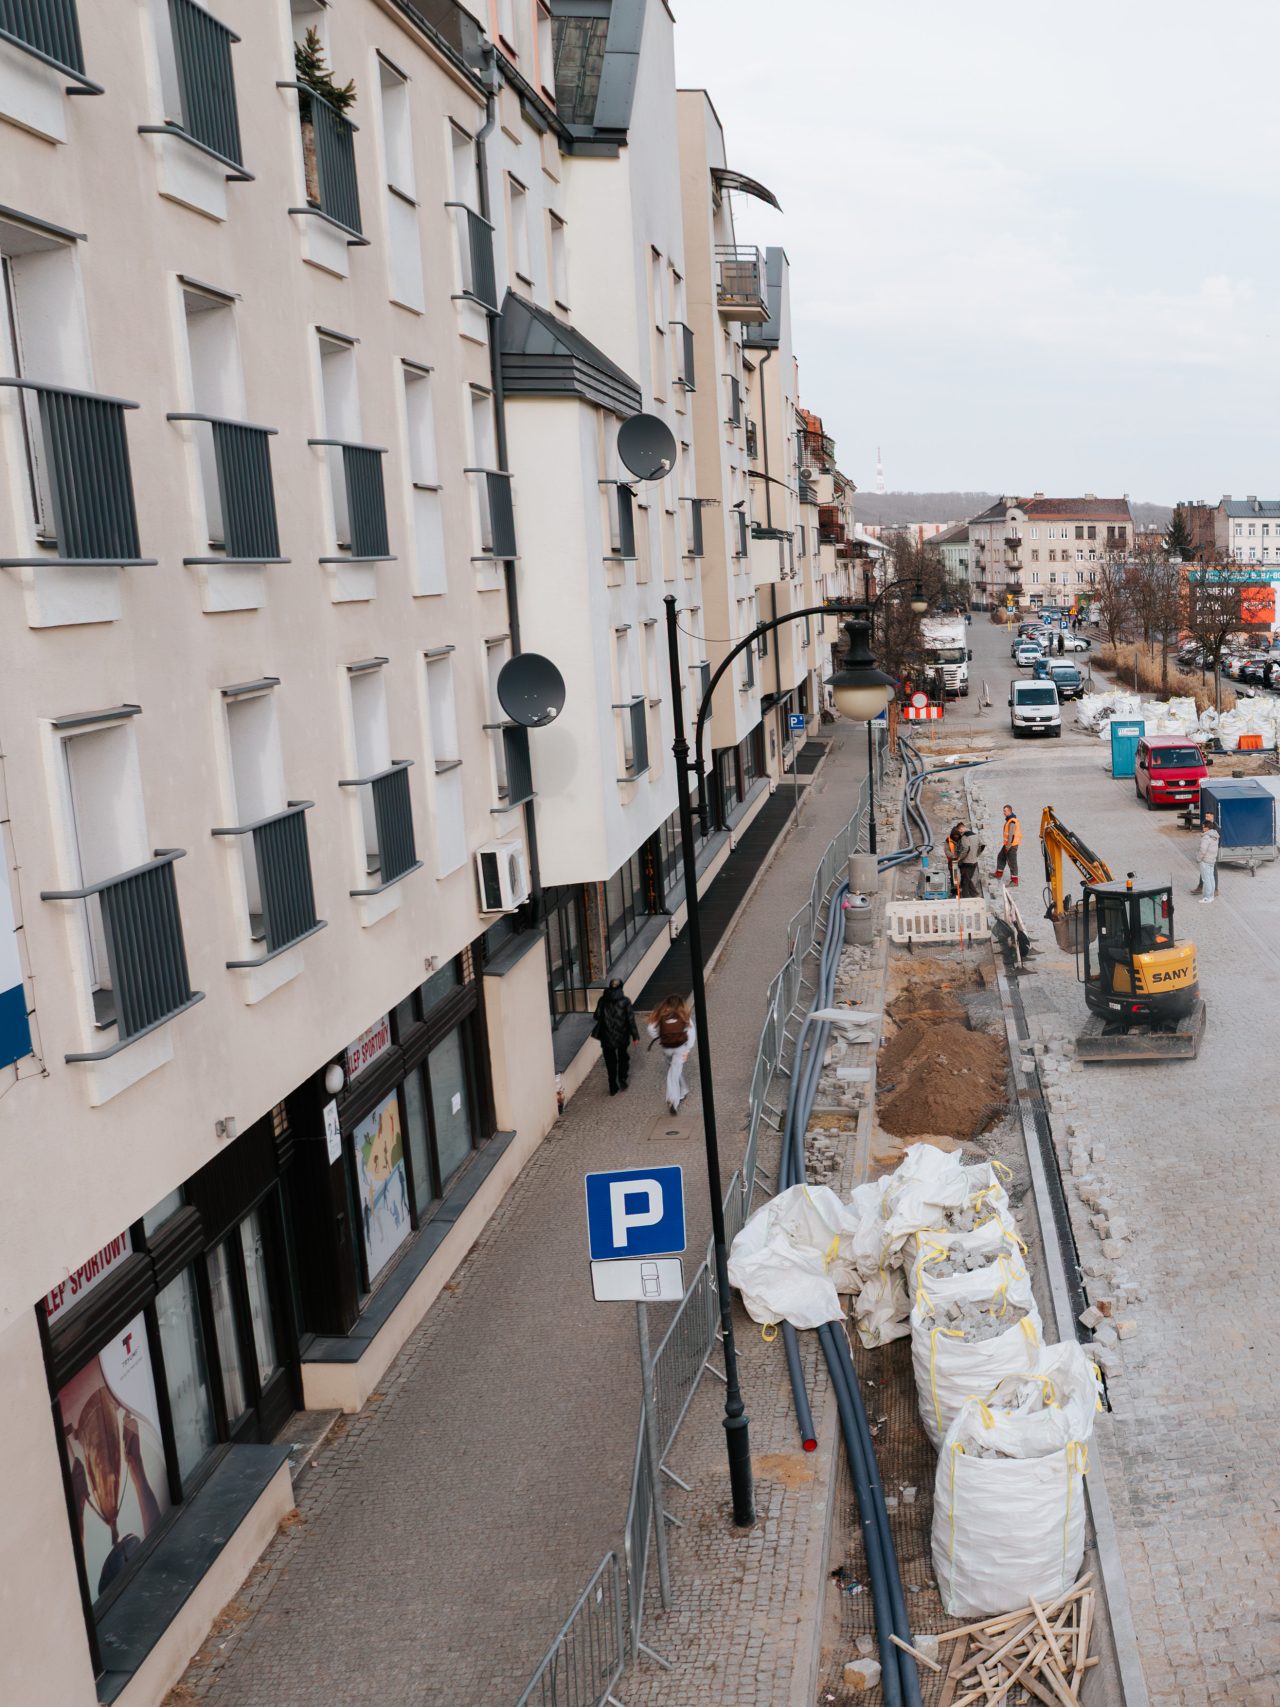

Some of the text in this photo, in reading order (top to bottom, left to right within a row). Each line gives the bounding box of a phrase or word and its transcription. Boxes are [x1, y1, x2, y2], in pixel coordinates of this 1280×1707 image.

[790, 717, 798, 727] P
[1152, 967, 1189, 984] SANY
[609, 1178, 664, 1248] P
[43, 1279, 69, 1317] LEP
